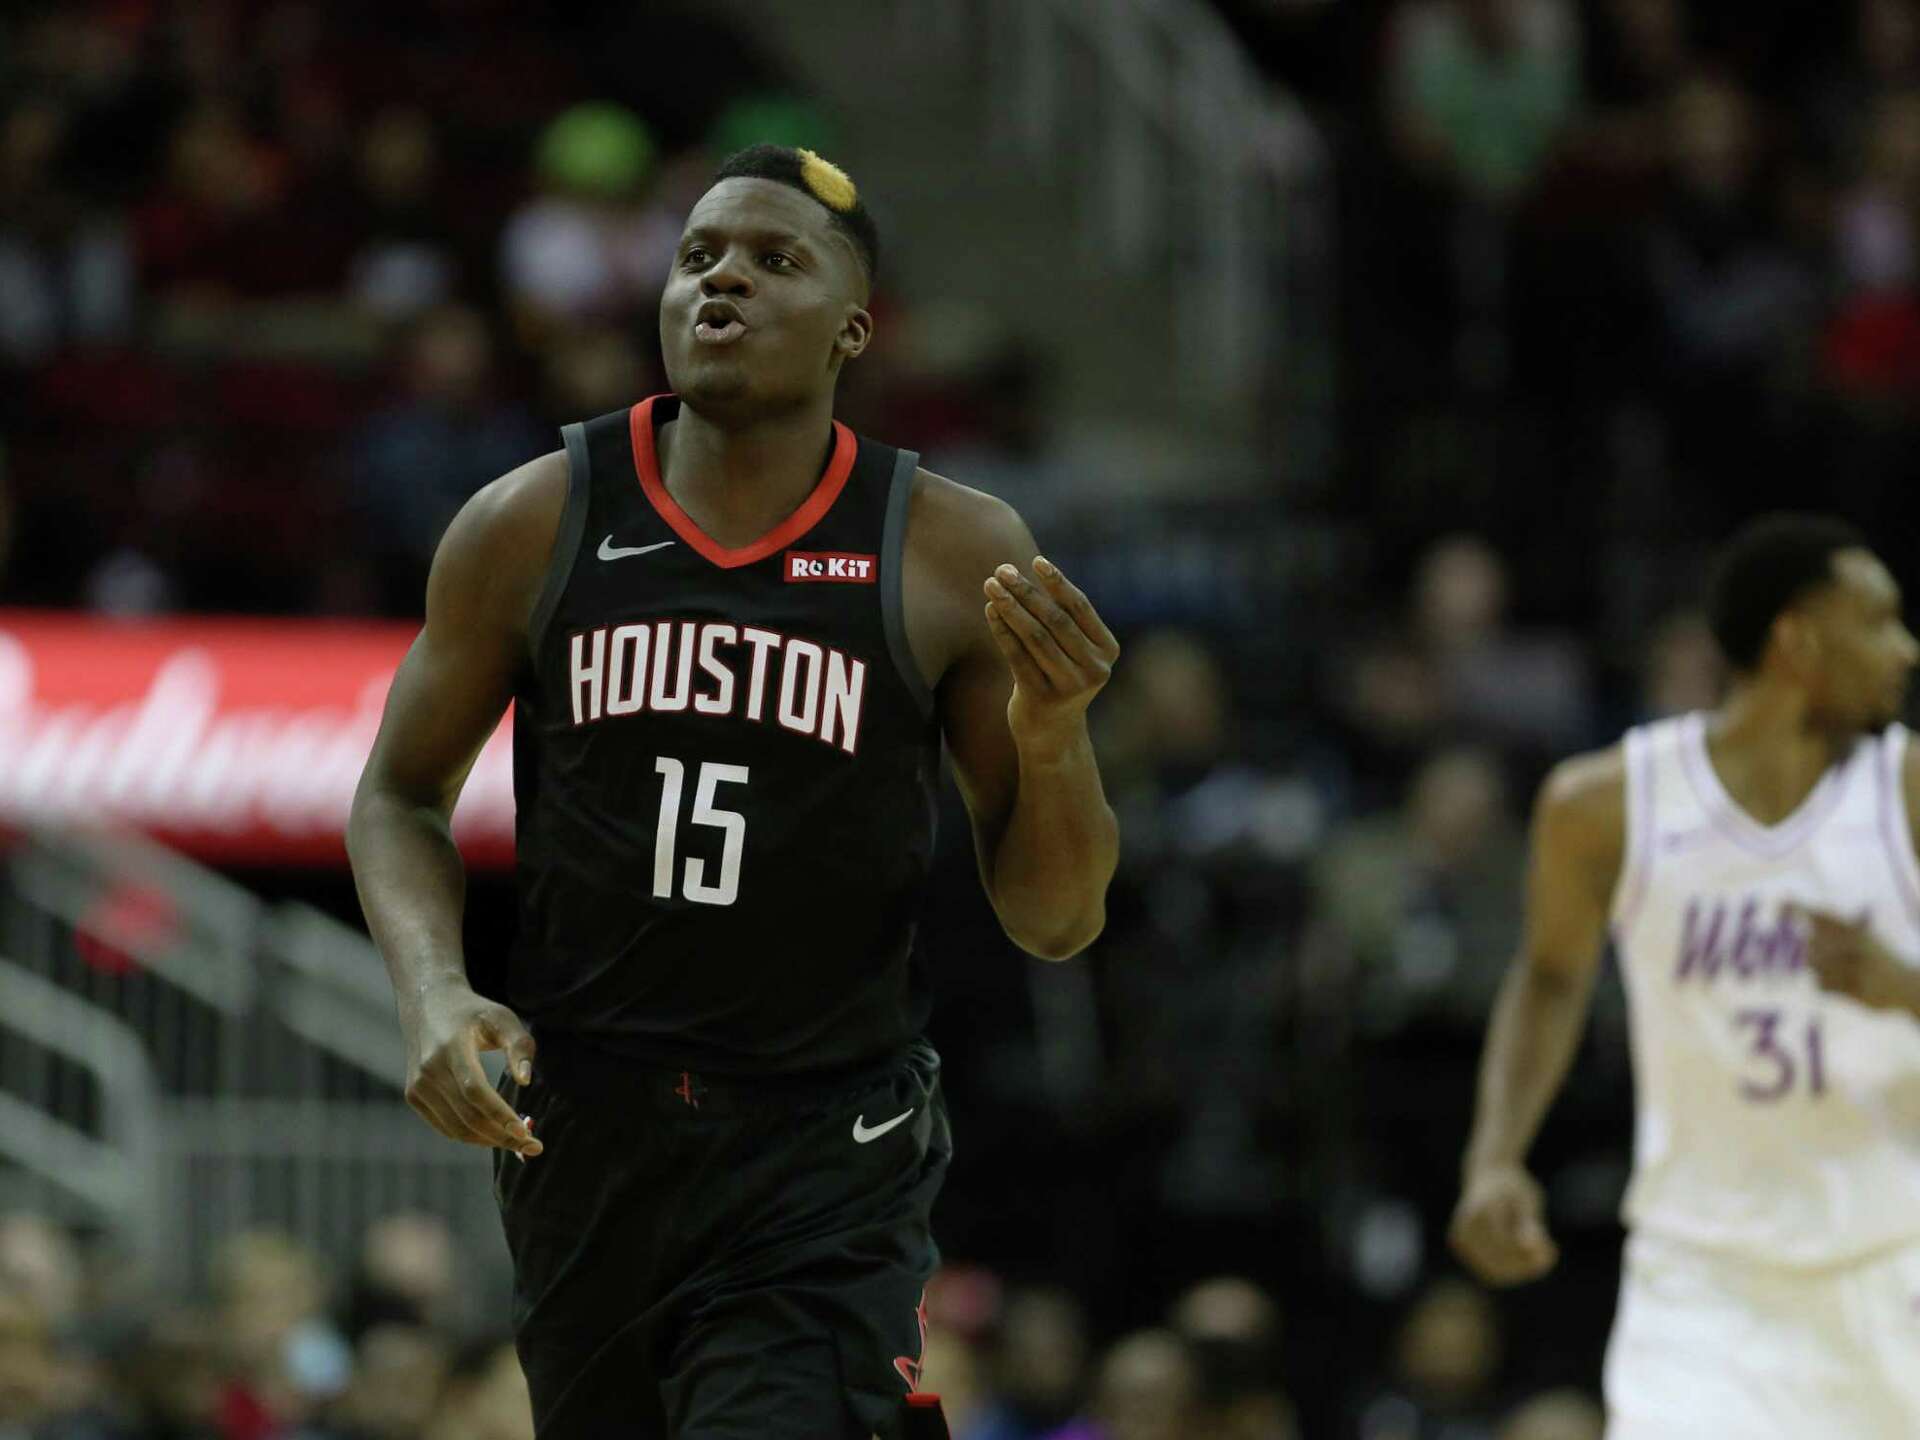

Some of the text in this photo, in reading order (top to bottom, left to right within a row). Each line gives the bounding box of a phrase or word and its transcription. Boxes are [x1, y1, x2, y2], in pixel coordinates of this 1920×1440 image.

[569, 621, 868, 756] HOUSTON
[652, 756, 750, 906] 15
[1733, 1008, 1825, 1104] 31
